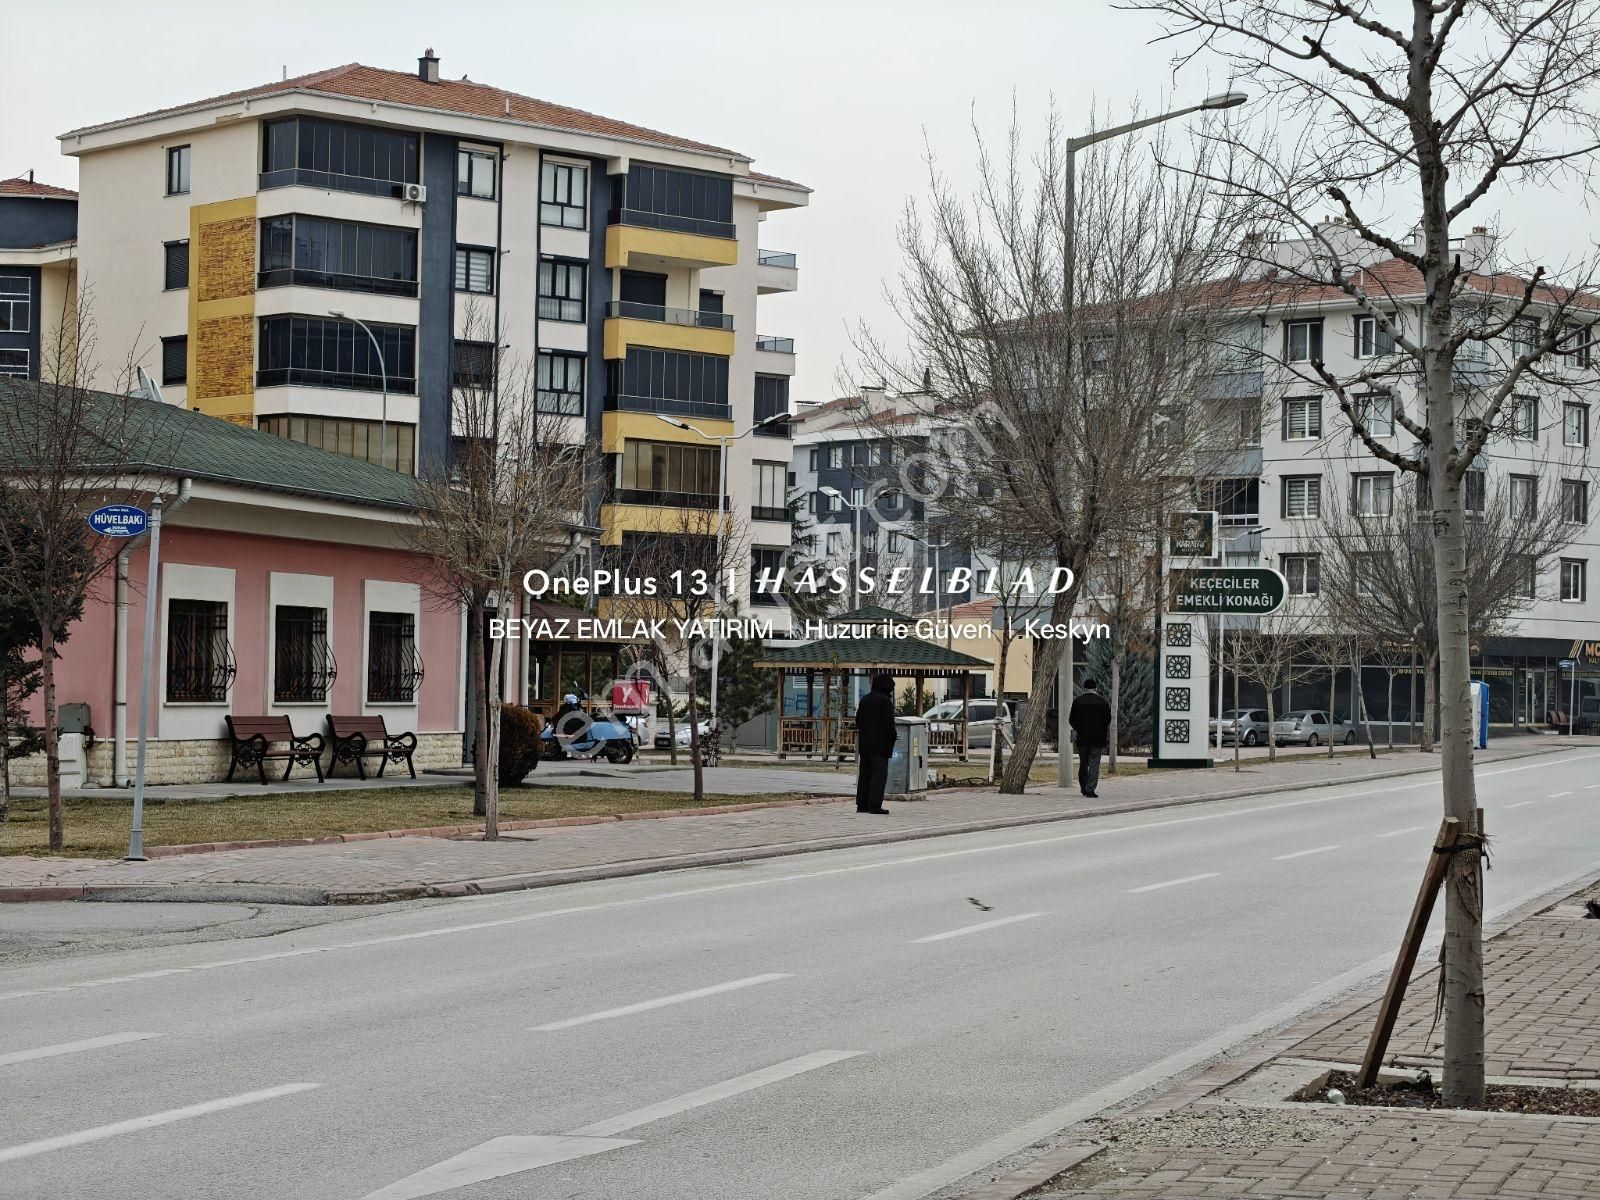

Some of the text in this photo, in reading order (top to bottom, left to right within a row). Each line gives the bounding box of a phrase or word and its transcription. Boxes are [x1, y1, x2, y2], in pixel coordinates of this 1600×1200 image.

[1190, 576, 1260, 591] KEÇECİLER
[1176, 593, 1273, 607] EMEKLİ KONAĞI
